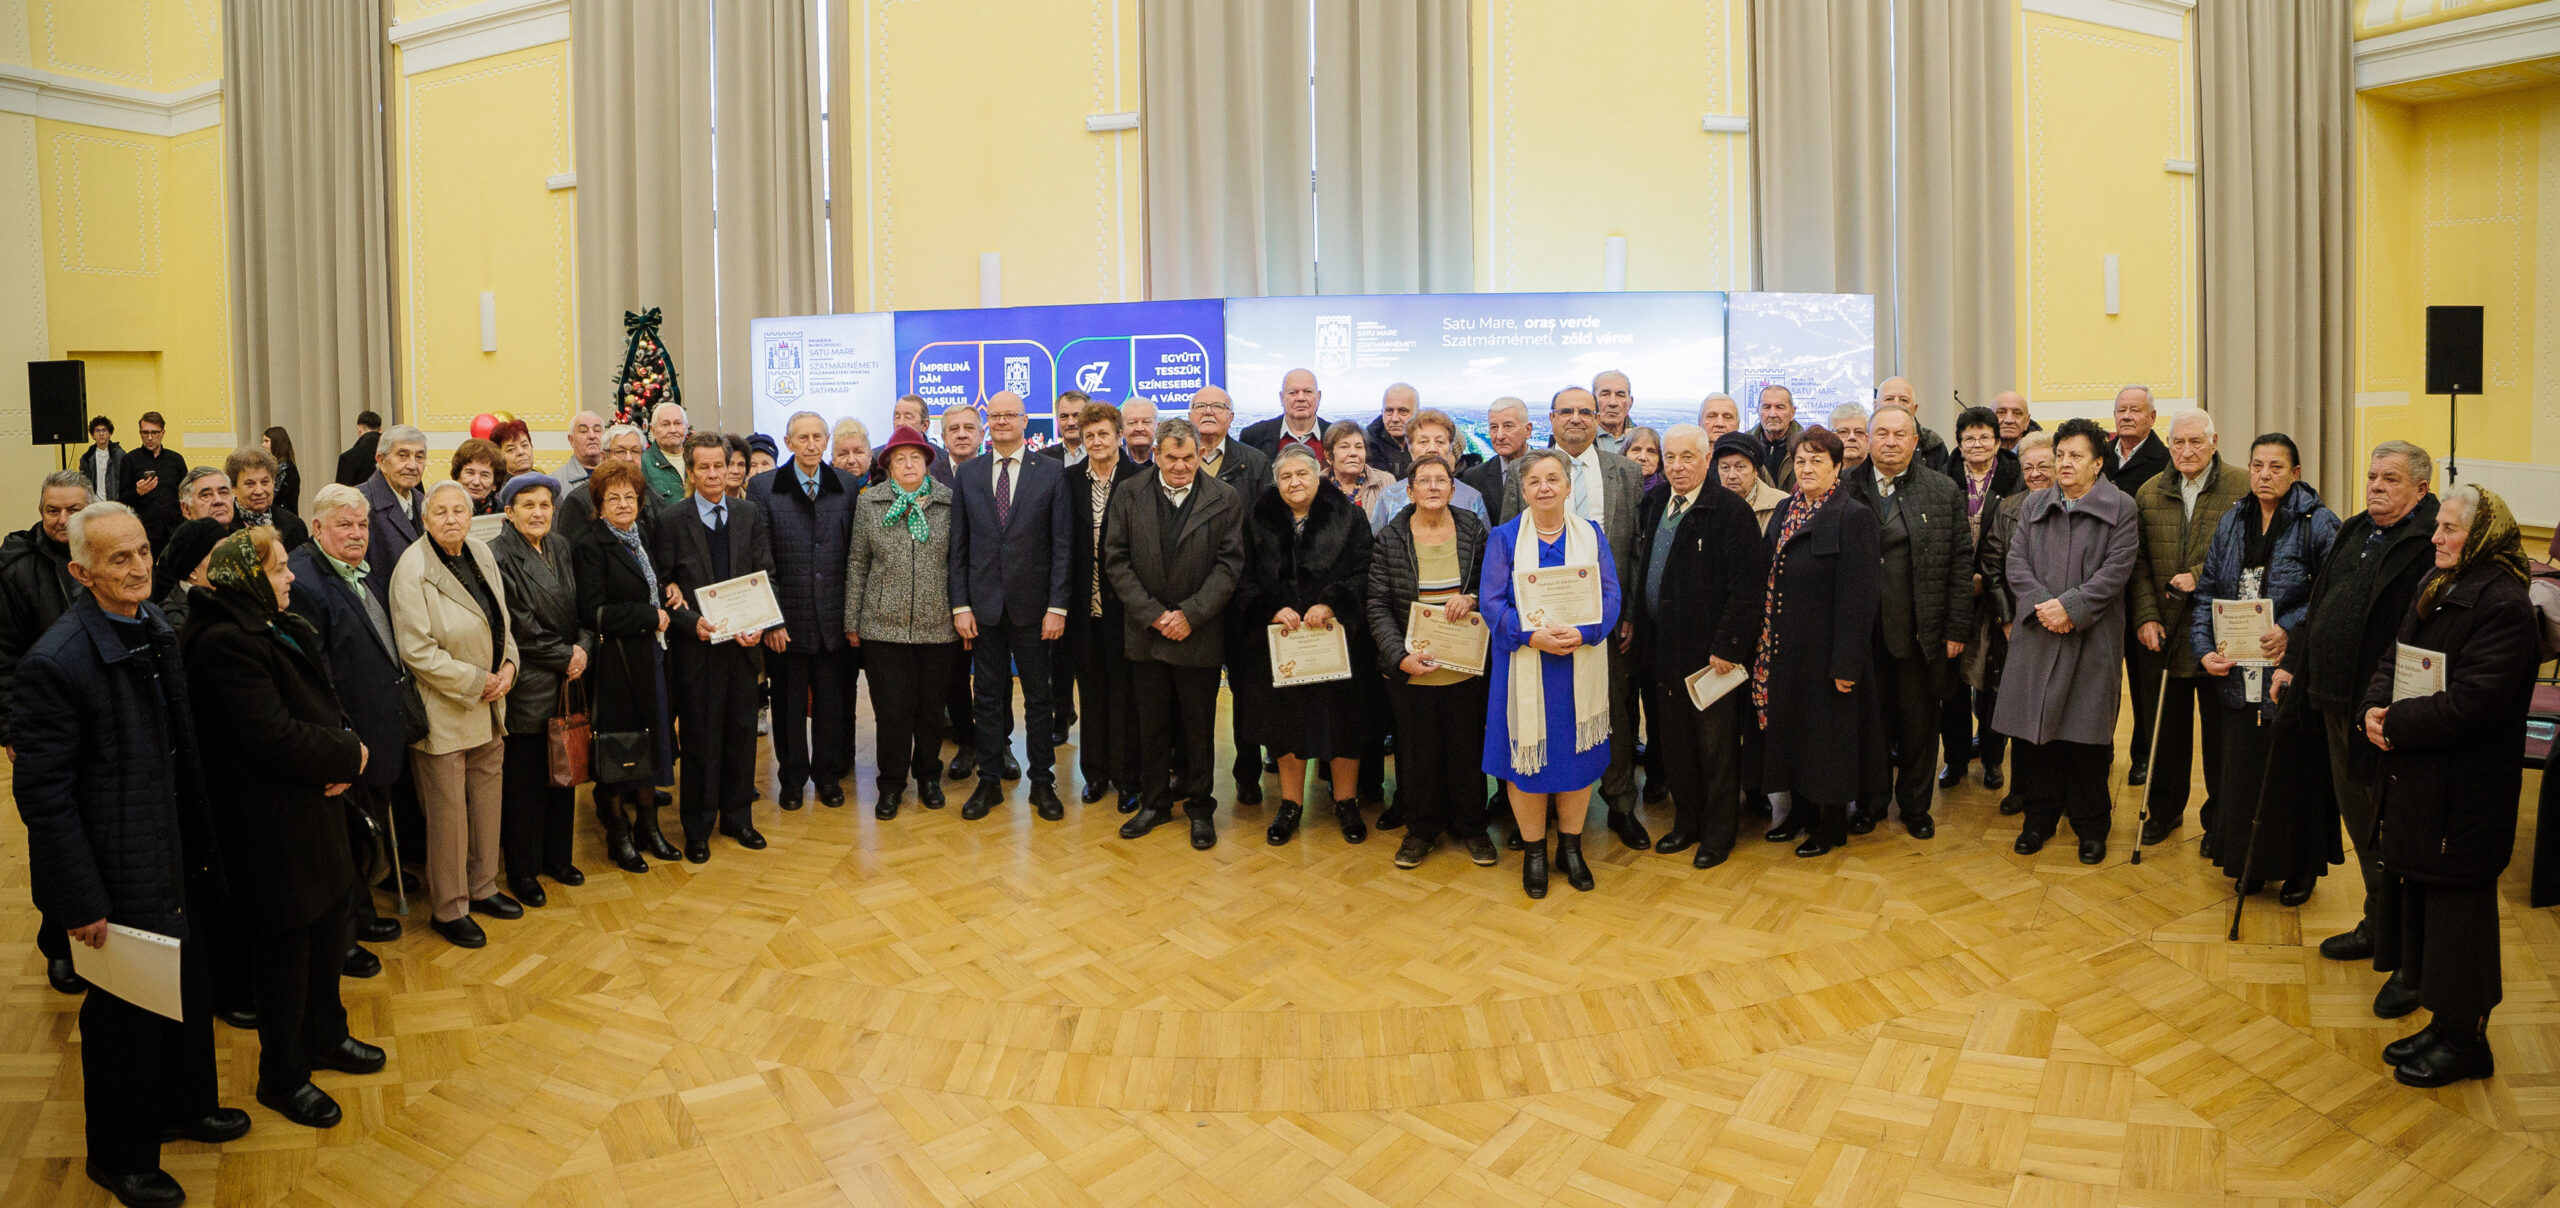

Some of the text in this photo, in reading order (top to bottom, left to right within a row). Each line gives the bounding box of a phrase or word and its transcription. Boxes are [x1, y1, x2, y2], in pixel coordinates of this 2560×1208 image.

[1442, 317, 1475, 330] Satu
[1479, 316, 1518, 331] Mare,
[1559, 315, 1601, 329] verde
[808, 347, 855, 356] SATU MARE
[1161, 351, 1202, 363] EGYÜTT
[808, 361, 879, 370] SZATMÁRNÉMETI
[919, 361, 971, 372] ÎMPREUNĂ
[1154, 364, 1202, 376] TESSZÜK
[919, 374, 941, 384] DĂM
[1138, 378, 1202, 390] SZÍNESEBBÉ
[809, 386, 850, 394] SATHMAR
[919, 385, 964, 395] CULOARE
[1791, 387, 1812, 395] SATU
[1150, 392, 1196, 403] A VÁROS
